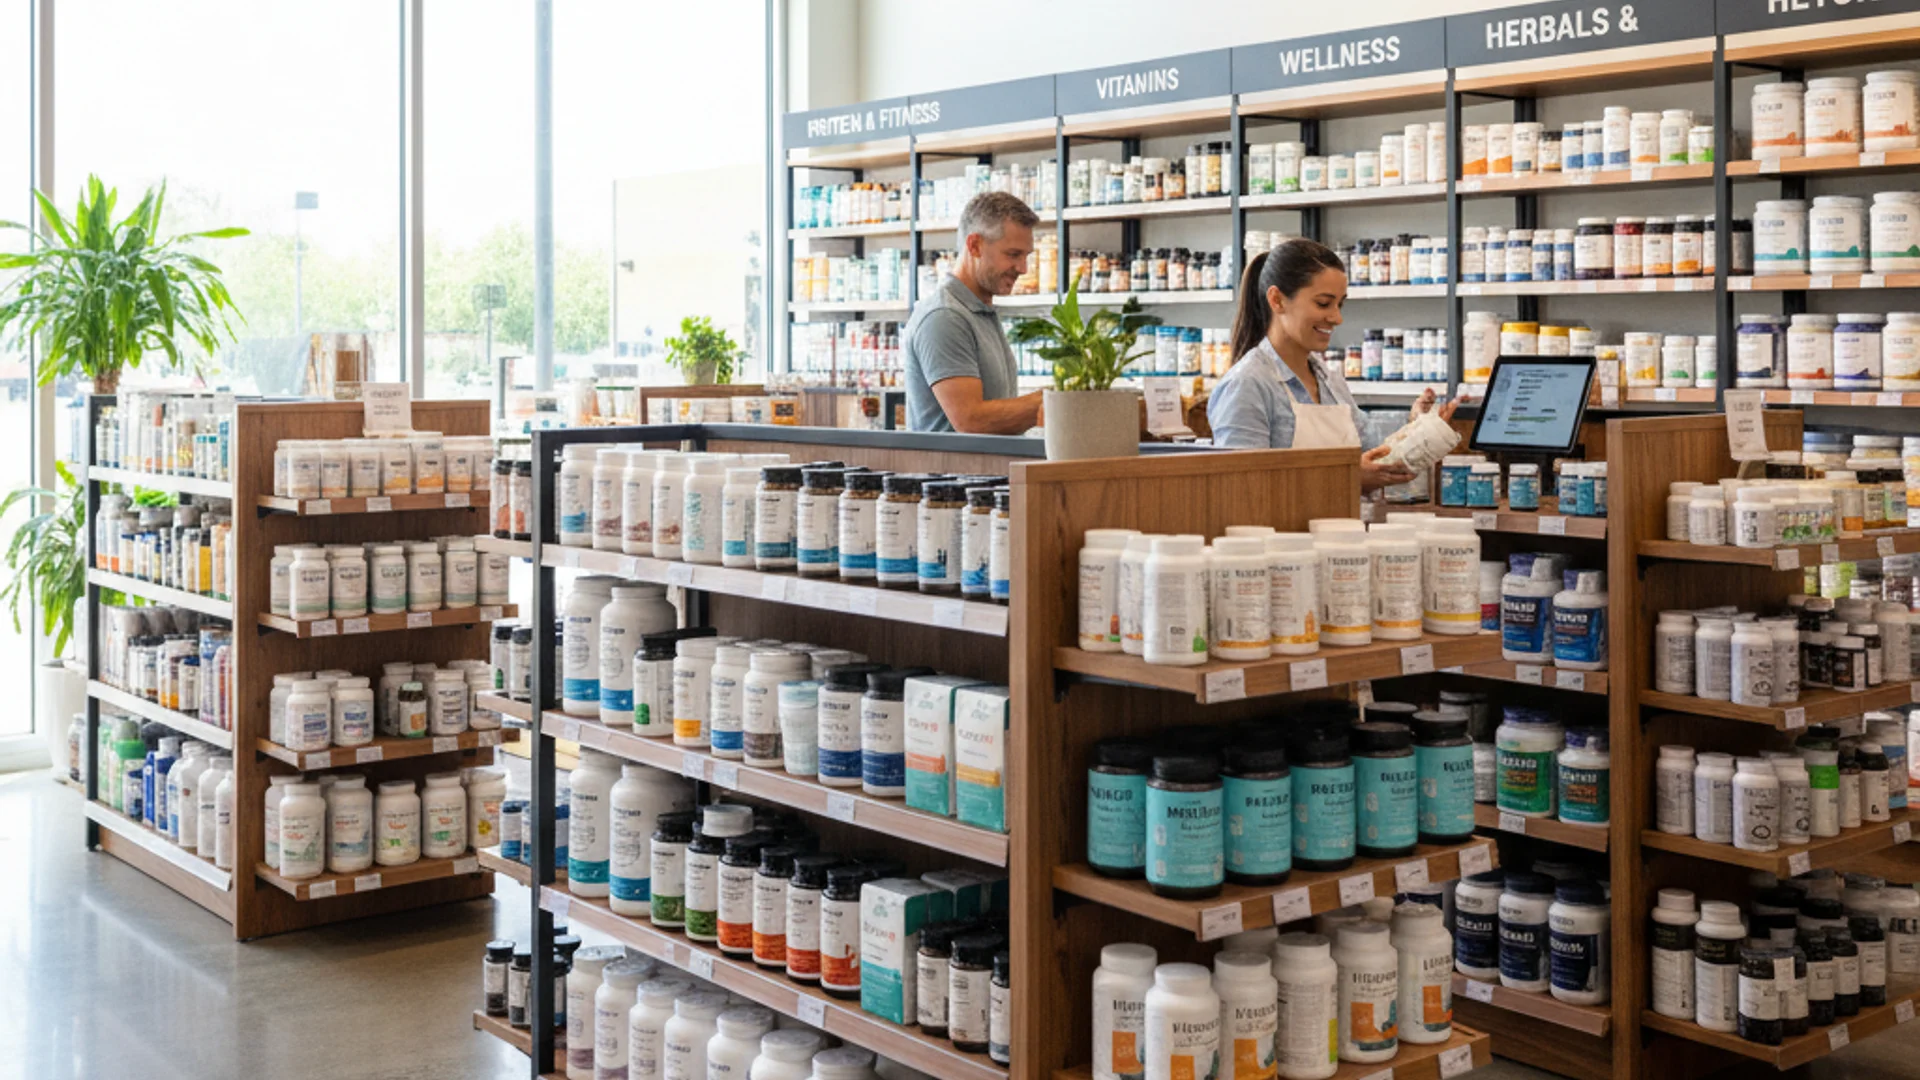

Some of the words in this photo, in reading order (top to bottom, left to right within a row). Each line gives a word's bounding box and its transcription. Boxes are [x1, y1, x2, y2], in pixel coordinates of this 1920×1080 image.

[1485, 8, 1610, 49] HERBALS
[1618, 4, 1639, 33] &
[1279, 35, 1400, 76] WELLNESS
[880, 101, 941, 129] FITNESS
